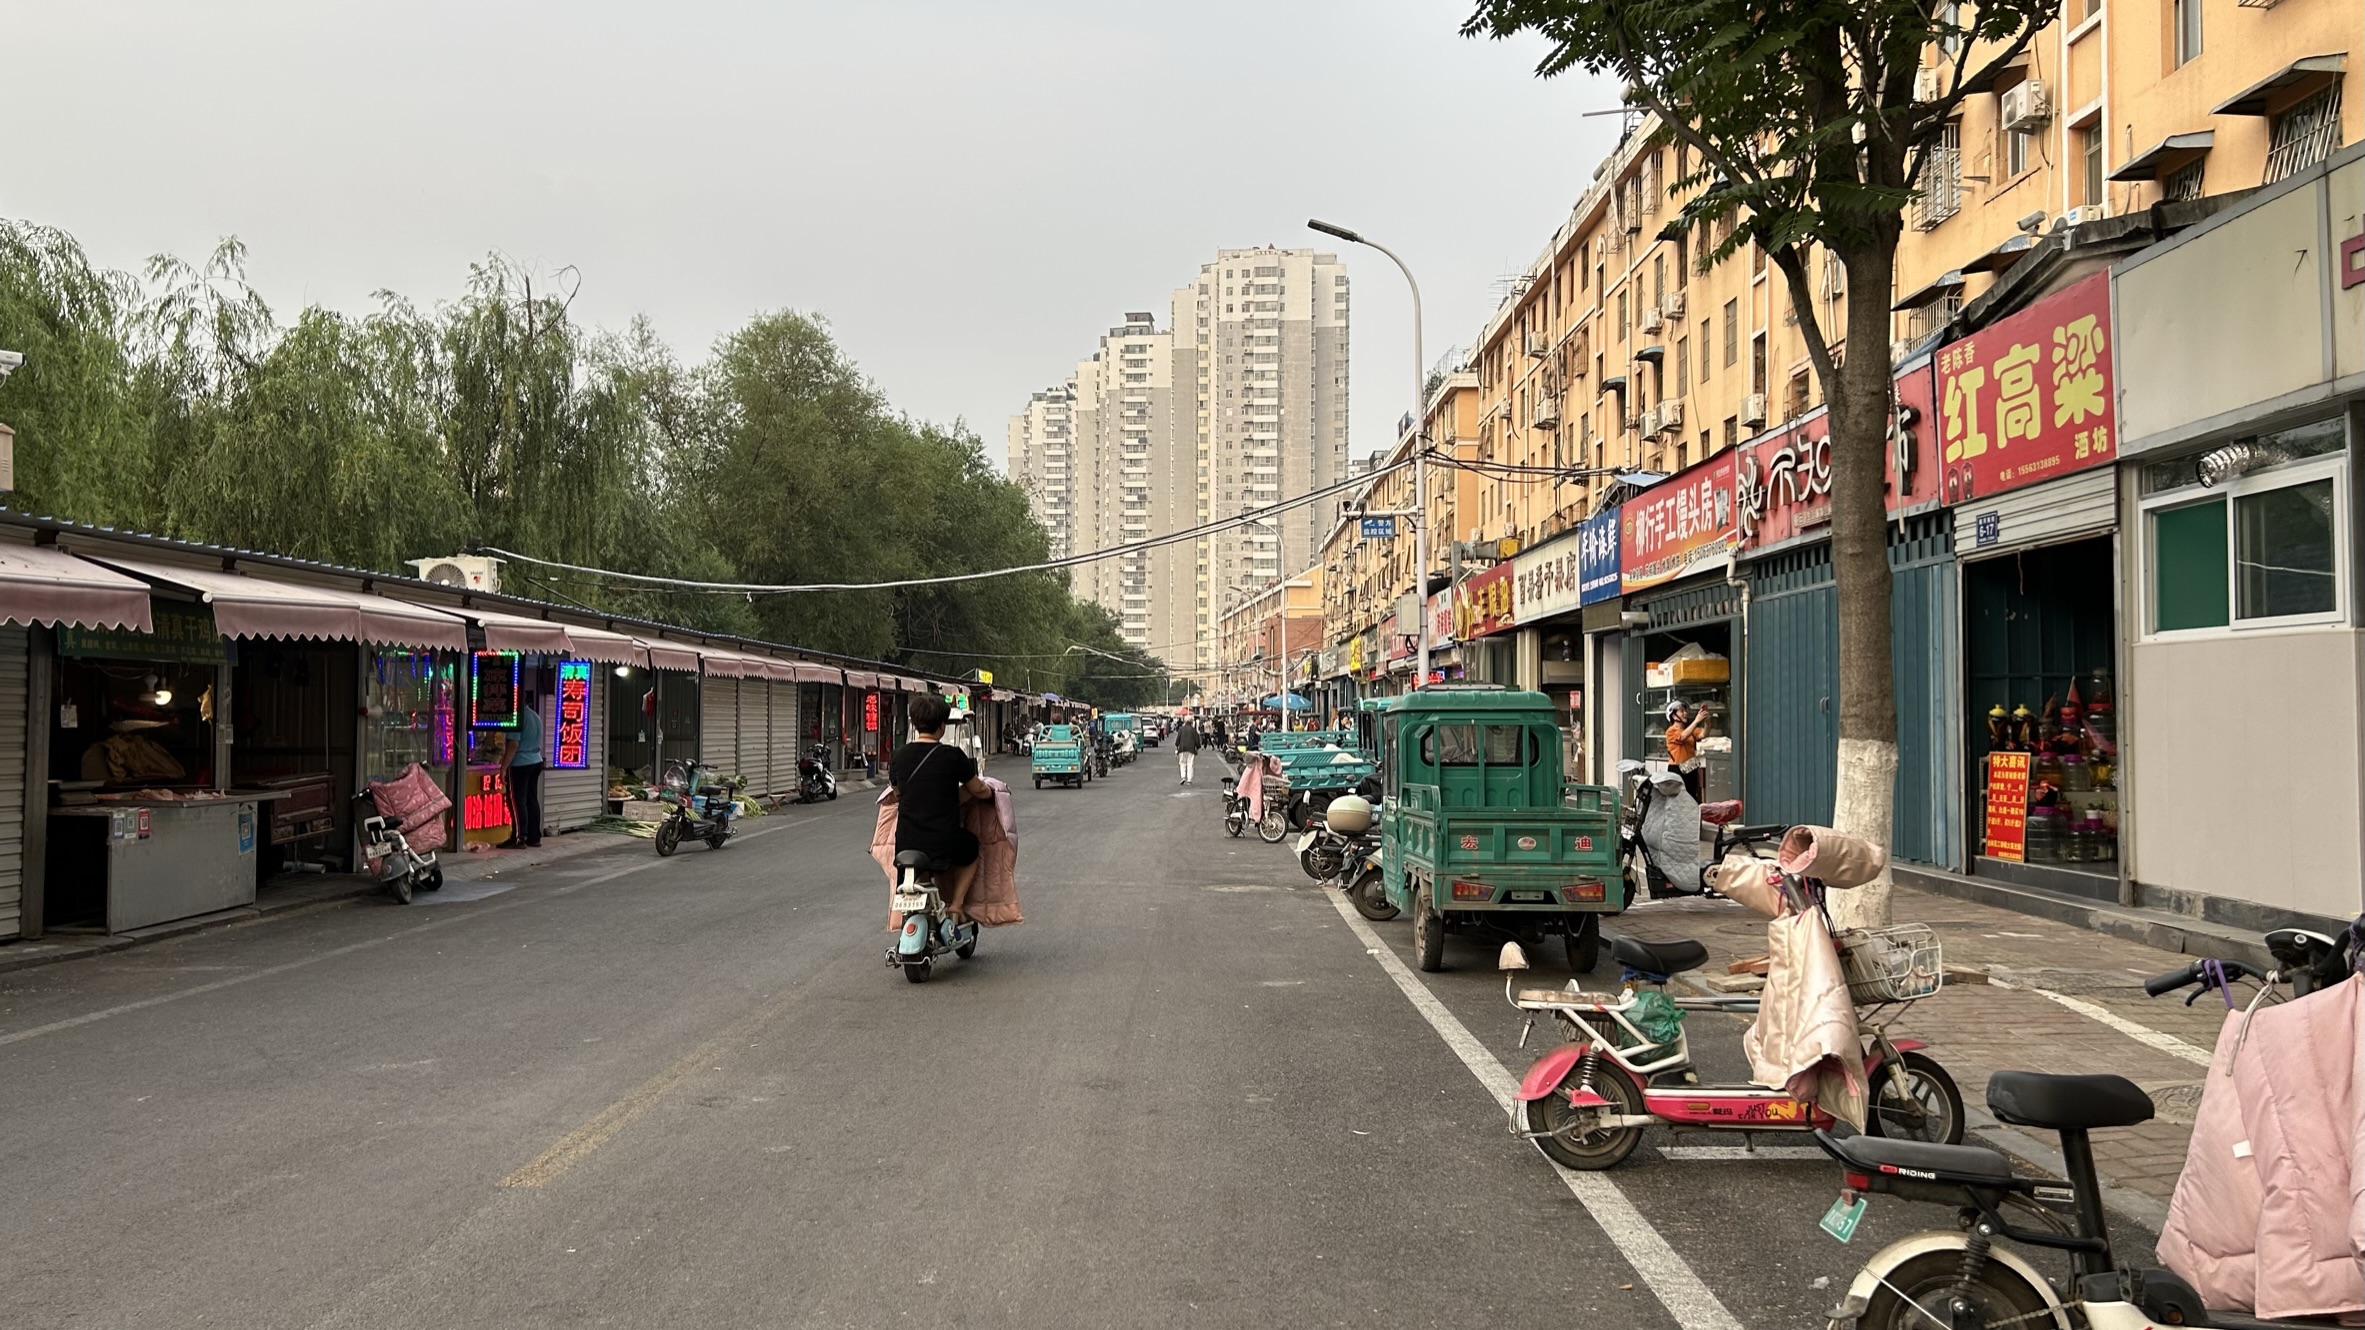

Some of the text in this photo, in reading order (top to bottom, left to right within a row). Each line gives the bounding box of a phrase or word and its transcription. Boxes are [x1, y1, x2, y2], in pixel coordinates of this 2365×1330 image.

[1941, 341, 1975, 375] 老陈香
[2074, 426, 2108, 460] 酒坊
[1635, 476, 1713, 558] 柳行手工馒头房
[1979, 523, 1995, 538] 6-17
[559, 680, 588, 763] 寿司饭团
[1992, 755, 2026, 769] 特大喜讯
[1461, 834, 1593, 851] 宏 迪
[1898, 1167, 1936, 1180] RIDING
